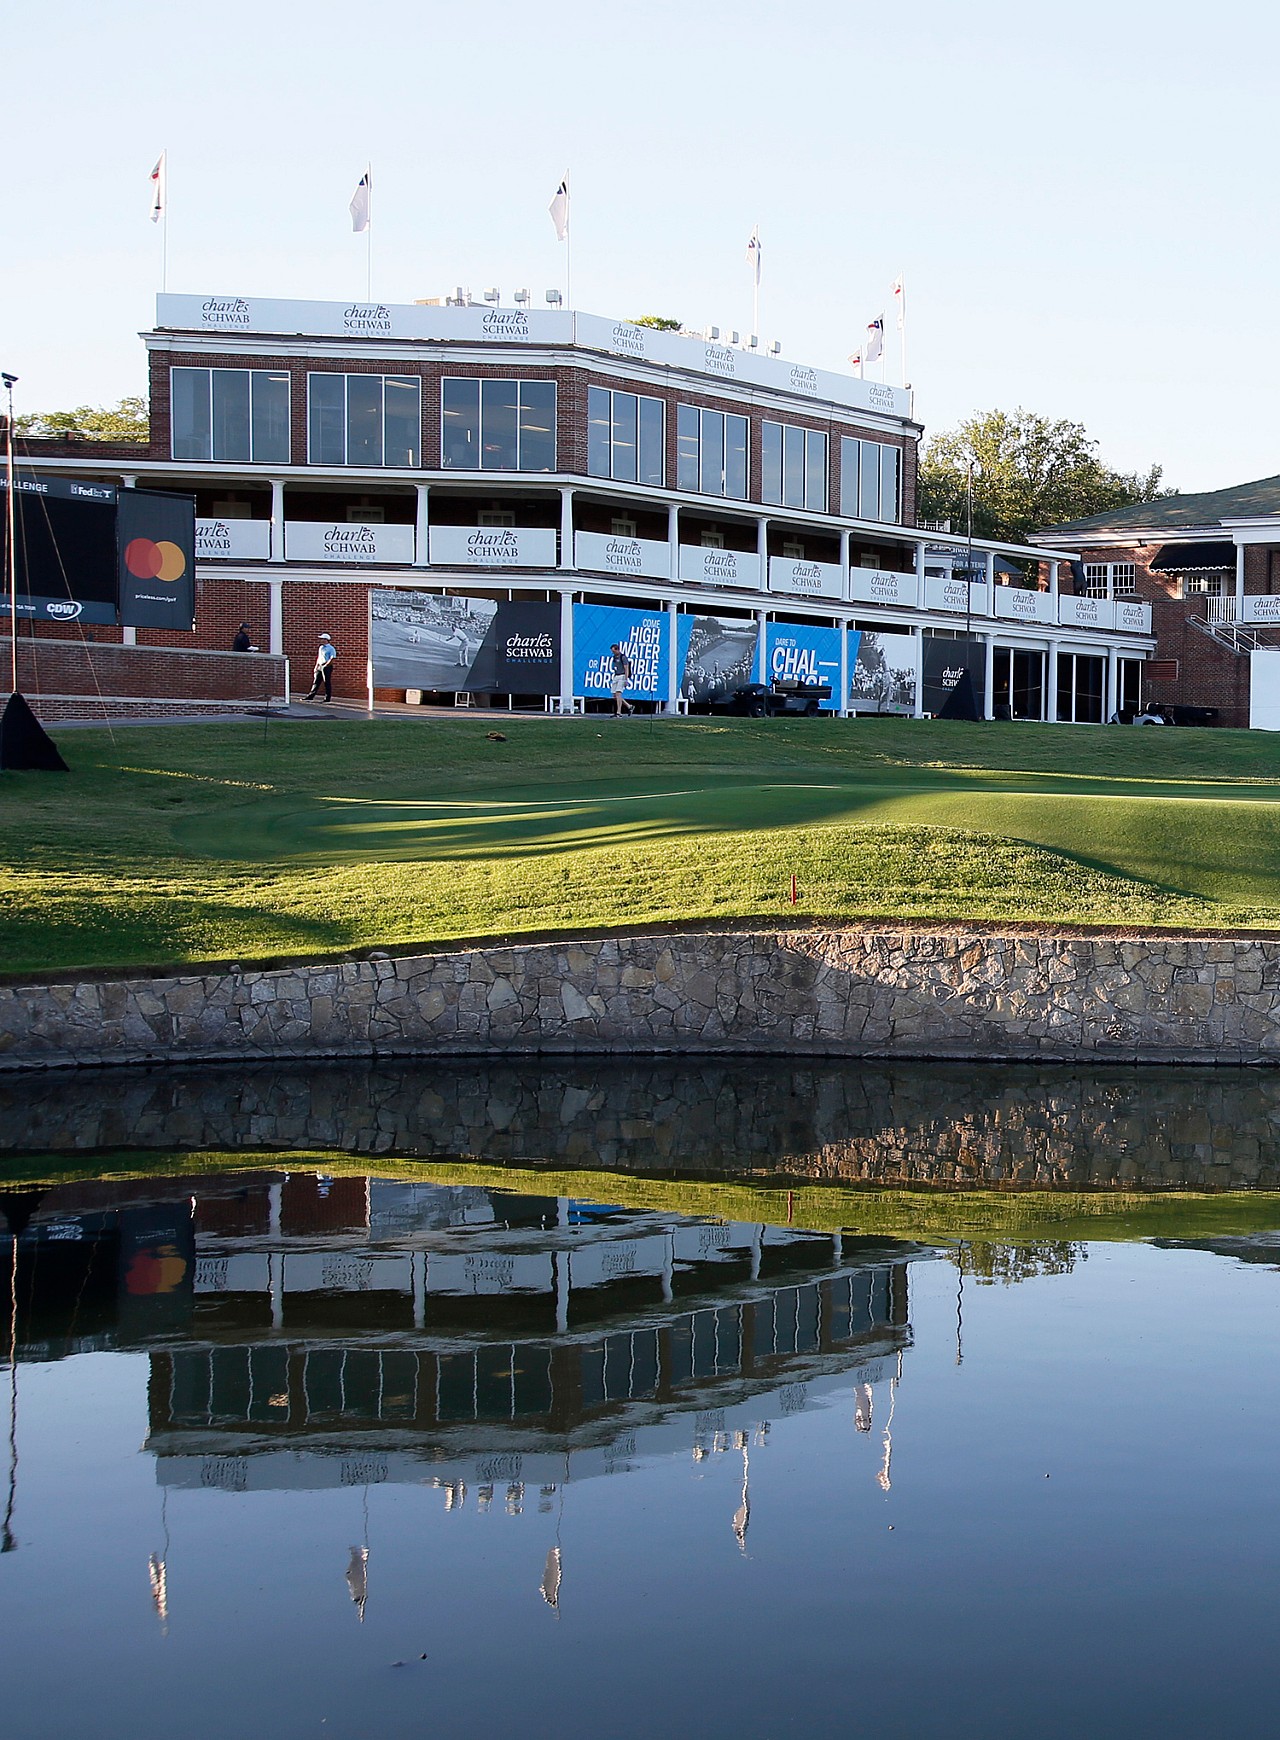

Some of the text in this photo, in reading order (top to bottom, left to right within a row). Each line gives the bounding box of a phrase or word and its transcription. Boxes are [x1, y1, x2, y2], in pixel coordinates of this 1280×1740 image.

[202, 298, 250, 312] charles
[202, 313, 250, 323] SCHWAB
[343, 305, 391, 319] charles
[482, 310, 528, 324] charles
[343, 320, 391, 330] SCHWAB
[482, 325, 529, 335] SCHWAB
[612, 324, 644, 340] charles
[612, 337, 644, 352] SCHWAB
[705, 346, 735, 362] charles
[705, 359, 735, 372] SCHWAB
[790, 378, 818, 390] SCHWAB
[869, 396, 894, 408] SCHWAB
[0, 478, 48, 492] HALLENGE
[195, 522, 230, 537] arles
[324, 526, 375, 542] charles
[195, 539, 230, 549] HWAB
[468, 530, 518, 546] charles
[324, 542, 376, 554] SCHWAB
[468, 547, 518, 557] SCHWAB
[606, 539, 642, 556] charles
[606, 555, 642, 567] SCHWAB
[704, 551, 736, 568] charles
[704, 566, 737, 578] SCHWAB
[792, 563, 822, 578] charles
[792, 578, 822, 588] SCHWAB
[870, 573, 898, 588] charles
[870, 587, 898, 597] SCHWAB
[642, 618, 660, 628] COME
[506, 633, 553, 648] charles
[630, 626, 660, 644] HIGH
[775, 638, 788, 646] DARE
[506, 648, 553, 658] SCHWAB
[620, 640, 660, 660] WATER
[588, 659, 598, 669] OR
